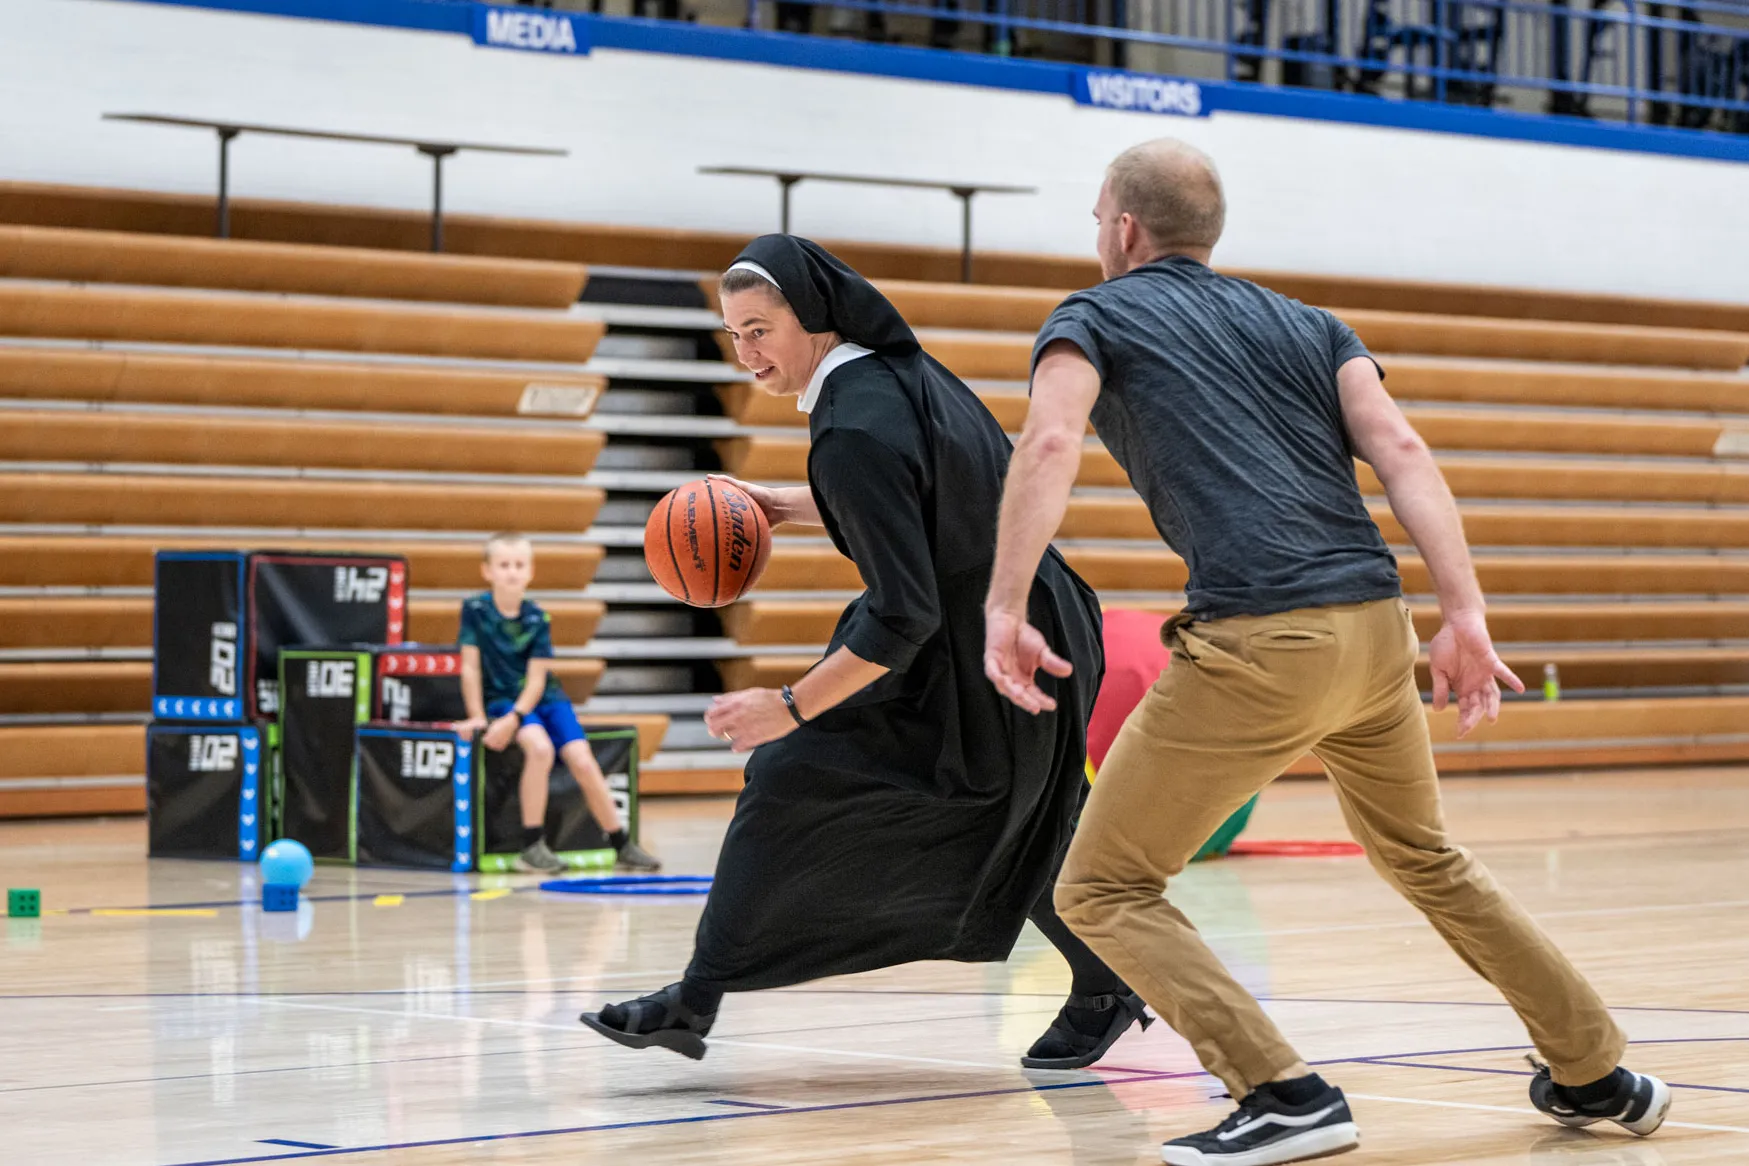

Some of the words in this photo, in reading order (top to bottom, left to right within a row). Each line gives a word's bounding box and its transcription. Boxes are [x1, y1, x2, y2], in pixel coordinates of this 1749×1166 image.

[486, 8, 577, 52] MEDIA
[1086, 72, 1202, 115] VISITORS
[688, 492, 704, 570] ELEMENT
[721, 490, 752, 571] Baden
[346, 567, 388, 602] 24
[210, 639, 237, 696] 20
[320, 660, 355, 697] 30
[201, 734, 238, 771] 20
[415, 740, 454, 778] 20
